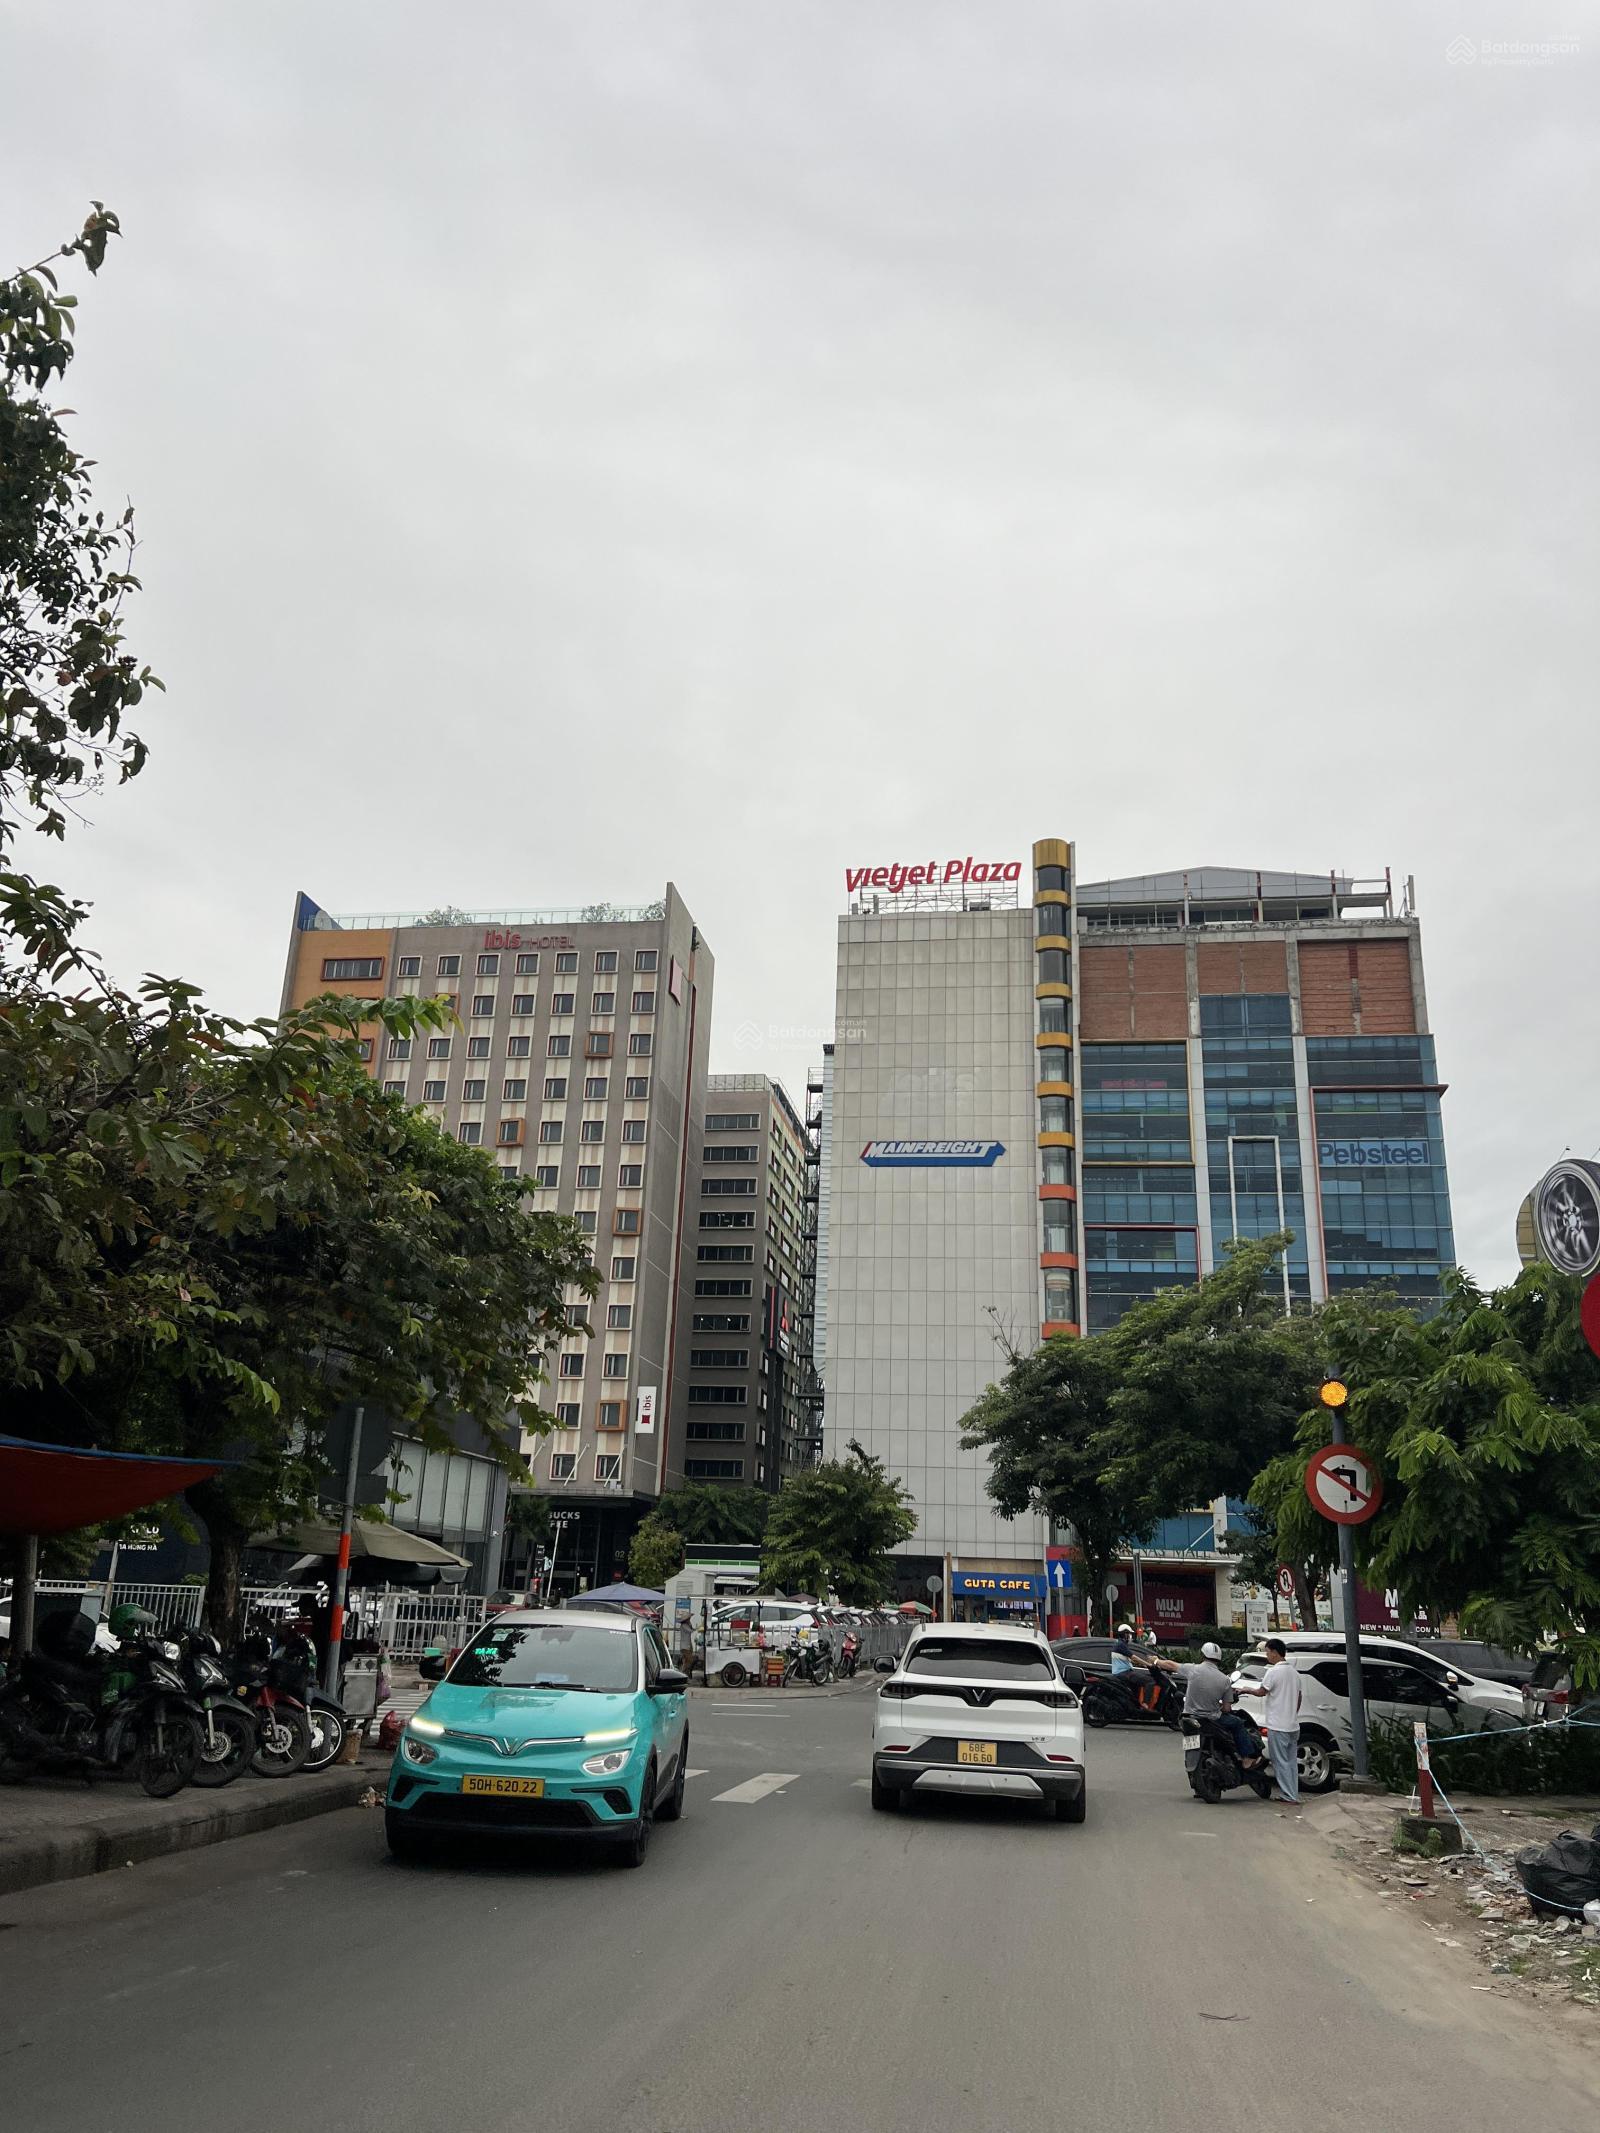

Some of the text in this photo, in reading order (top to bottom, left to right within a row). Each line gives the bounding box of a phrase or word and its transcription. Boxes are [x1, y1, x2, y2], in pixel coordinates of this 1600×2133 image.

[943, 856, 1022, 884] Plaza
[484, 928, 576, 951] ibis HOTEL
[864, 1141, 998, 1158] MAINFREIGHT
[1319, 1142, 1429, 1165] Pebsteel
[643, 1395, 652, 1411] ibis
[964, 1578, 1031, 1590] GUTA CAFE
[1155, 1598, 1184, 1612] MUJI
[1360, 1623, 1377, 1631] NEW
[968, 1743, 986, 1753] 68E
